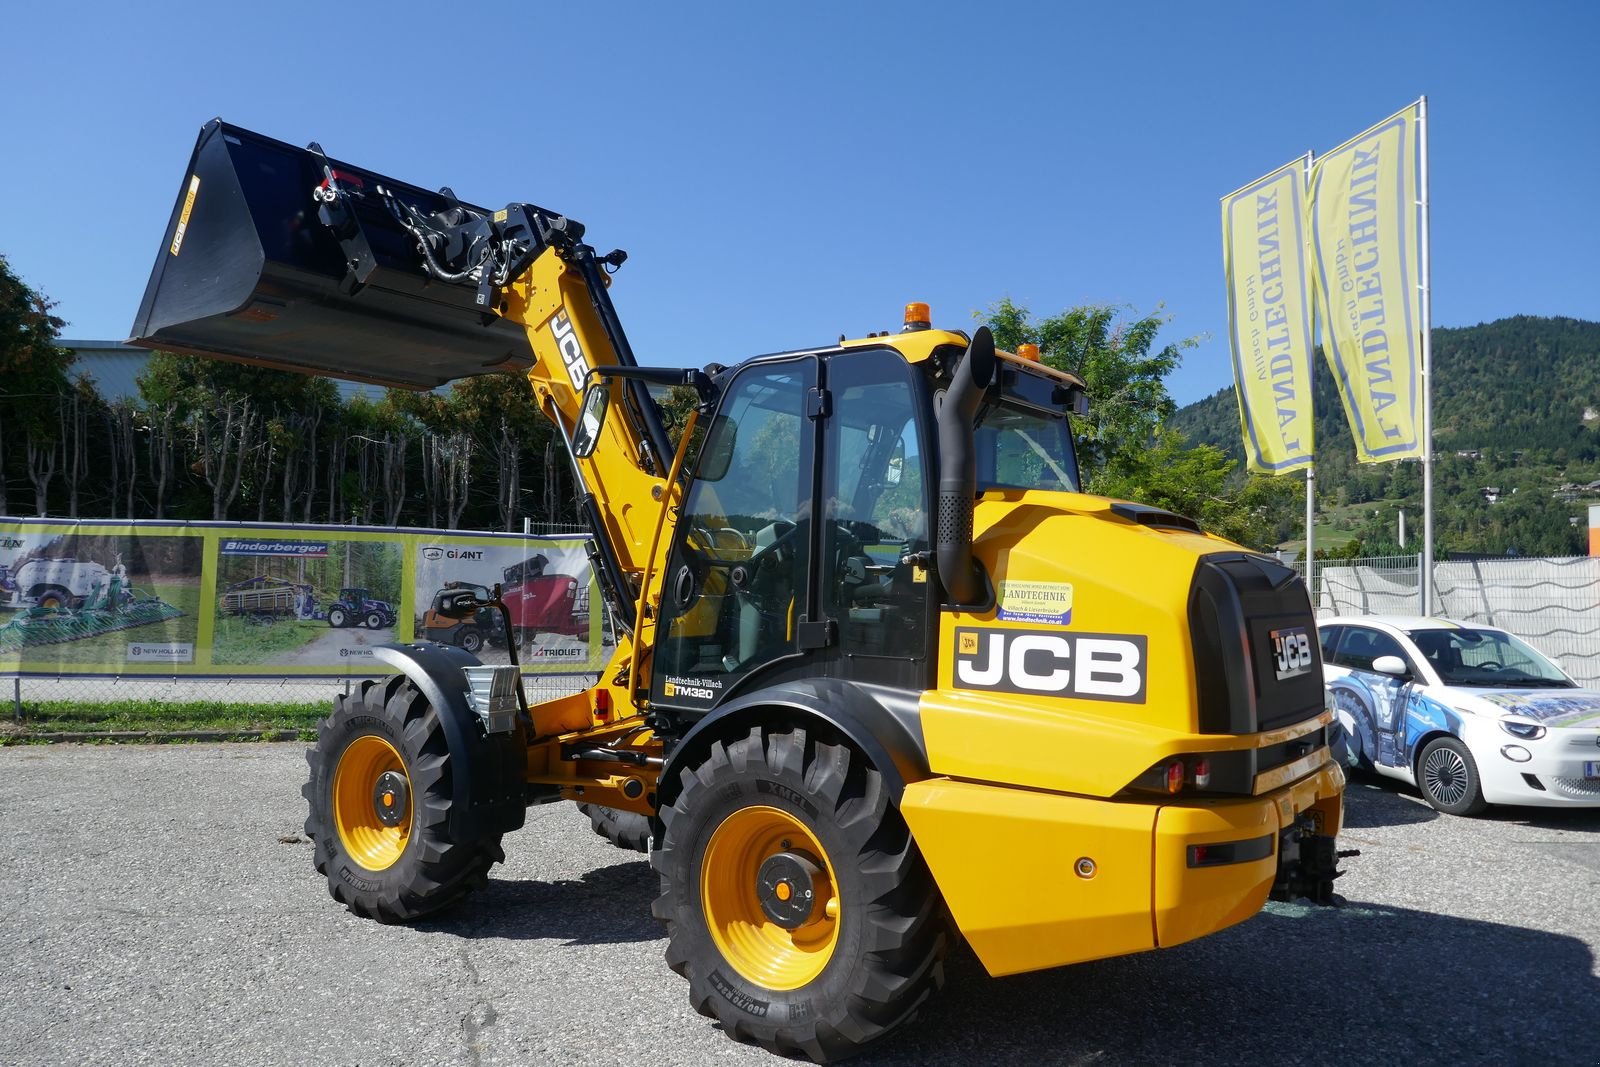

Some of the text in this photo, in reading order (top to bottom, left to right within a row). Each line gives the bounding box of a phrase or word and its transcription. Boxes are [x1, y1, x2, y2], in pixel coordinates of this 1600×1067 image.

[550, 316, 592, 390] JCB
[225, 542, 325, 553] Binderberger
[1003, 589, 1066, 601] LANDTECHNIK
[1003, 616, 1063, 625] www.landtechnik.co.at
[1275, 634, 1312, 671] JCB
[957, 633, 1141, 697] JCB
[665, 675, 723, 689] Landtechnik-Villach
[674, 685, 714, 699] TM320
[341, 868, 380, 892] MICHELIN
[716, 983, 734, 1000] R24
[733, 996, 766, 1016] 460/70
